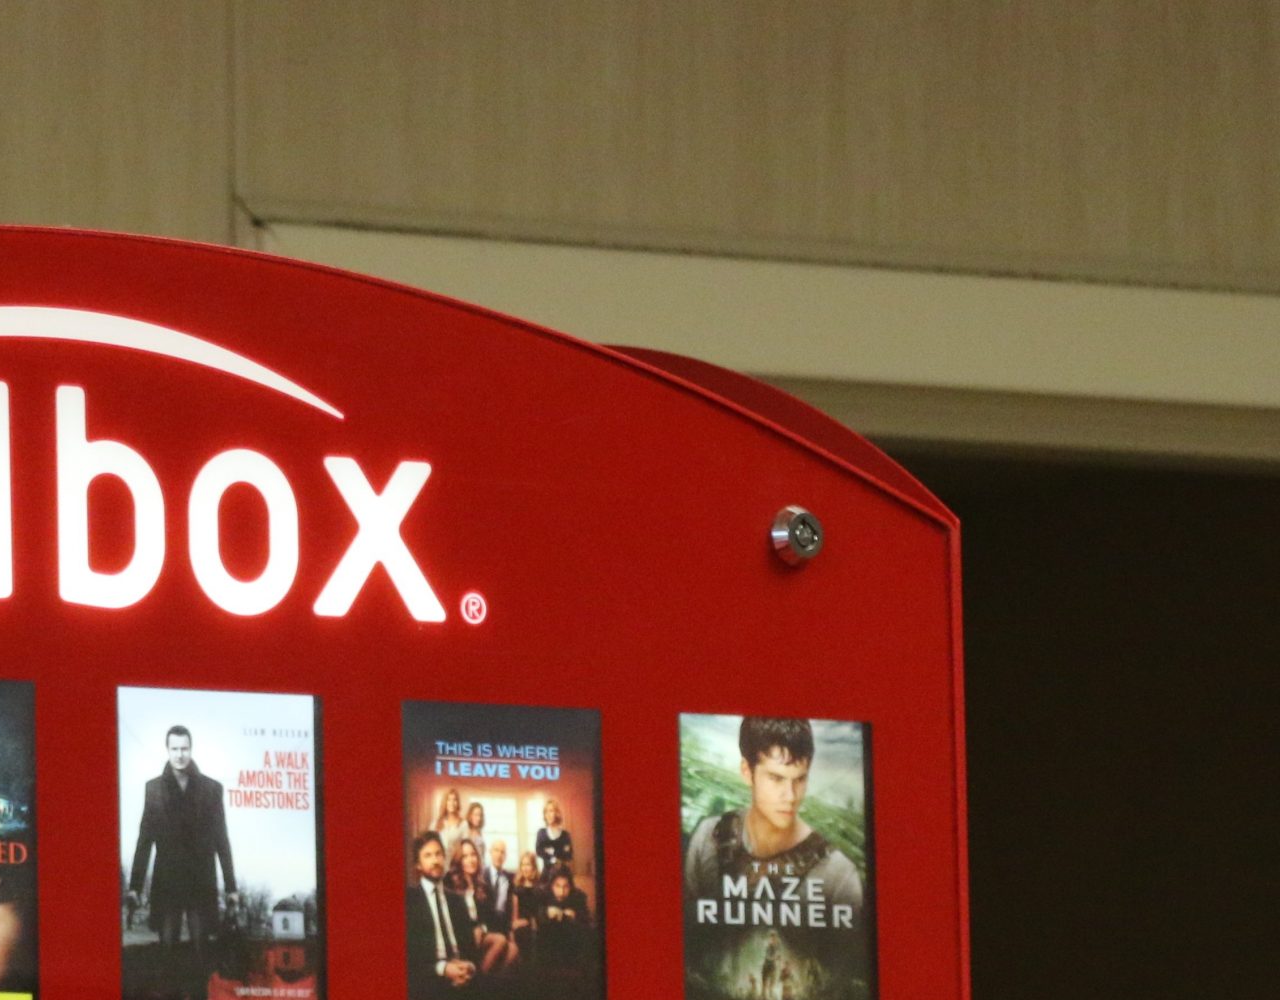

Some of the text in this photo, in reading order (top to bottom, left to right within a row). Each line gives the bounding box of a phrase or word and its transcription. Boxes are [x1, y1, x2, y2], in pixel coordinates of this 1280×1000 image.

[263, 750, 309, 770] A WALK
[435, 741, 560, 761] THIS IS WHERE
[238, 769, 309, 790] AMONG THE
[435, 760, 561, 780] I LEAVE YOU
[227, 788, 310, 810] TOMBSTONES
[752, 861, 795, 875] THE
[723, 874, 825, 901] MAZE
[697, 899, 853, 928] RUNNER
